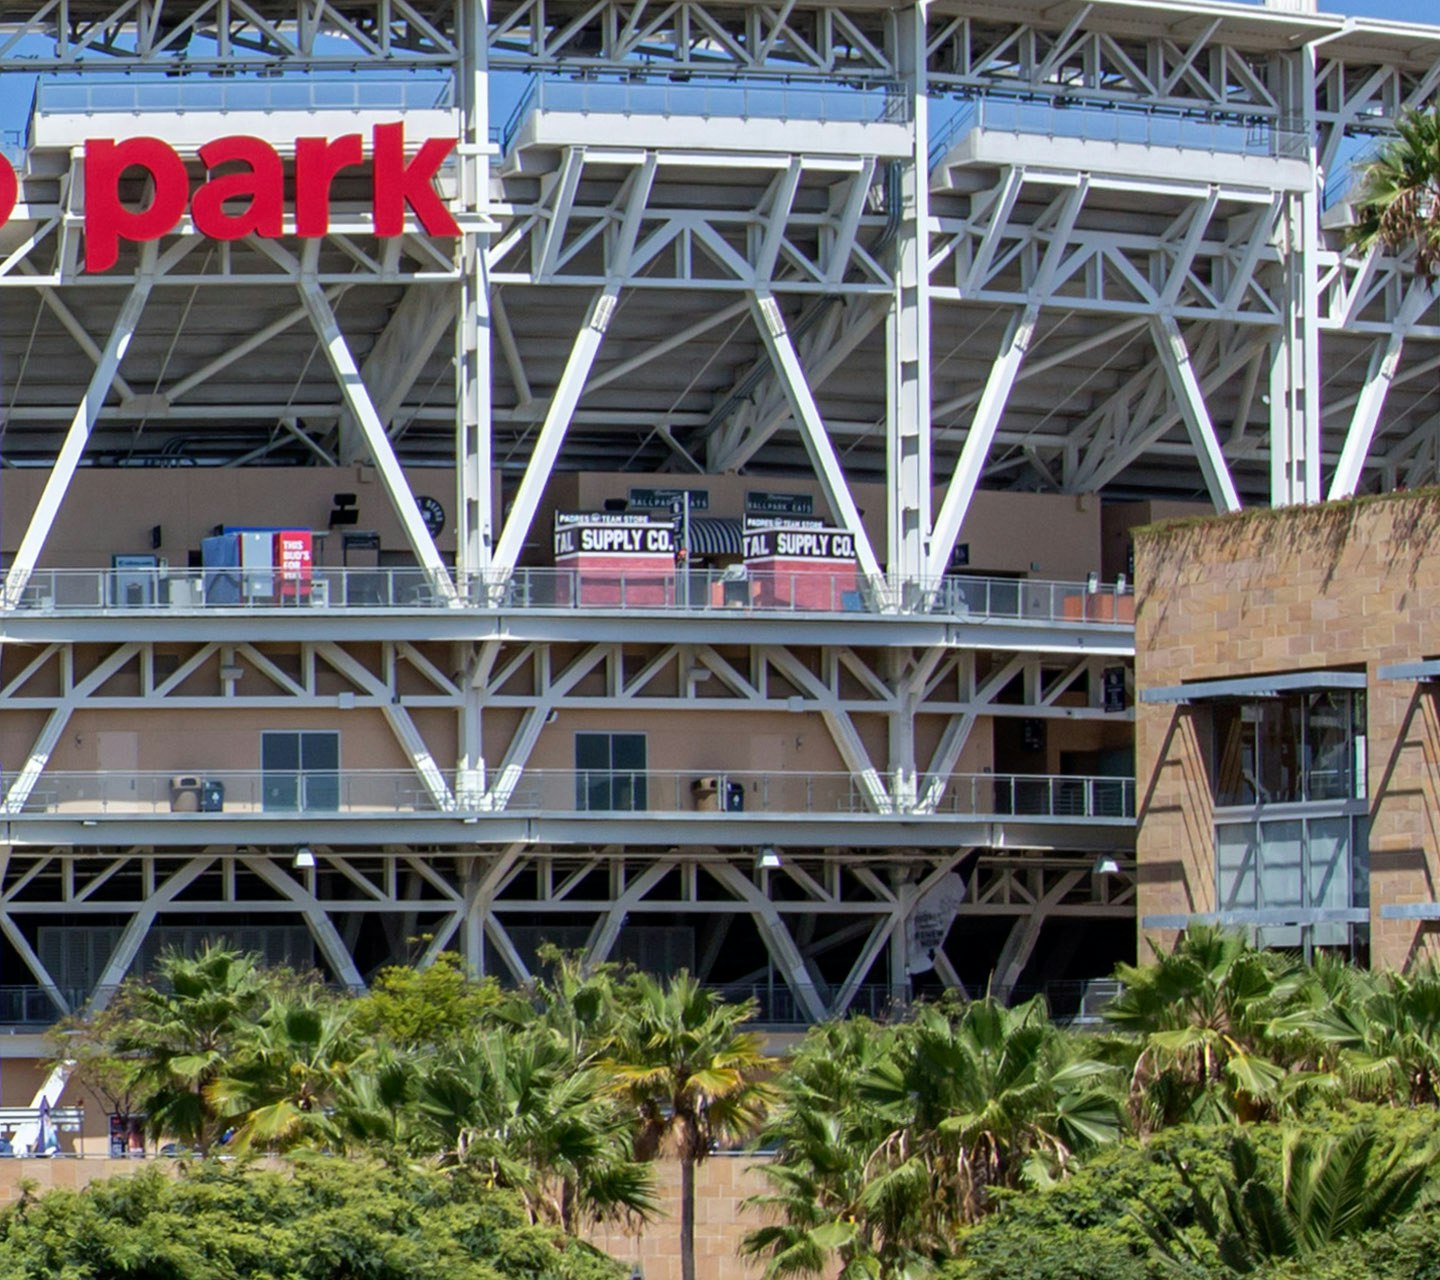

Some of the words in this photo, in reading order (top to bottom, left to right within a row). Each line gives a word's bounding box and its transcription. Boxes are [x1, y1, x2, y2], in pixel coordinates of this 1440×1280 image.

[83, 121, 464, 273] park
[582, 529, 643, 551] SUPPLY
[647, 530, 674, 551] CO.
[777, 533, 829, 555] SUPPLY
[832, 535, 855, 557] CO.
